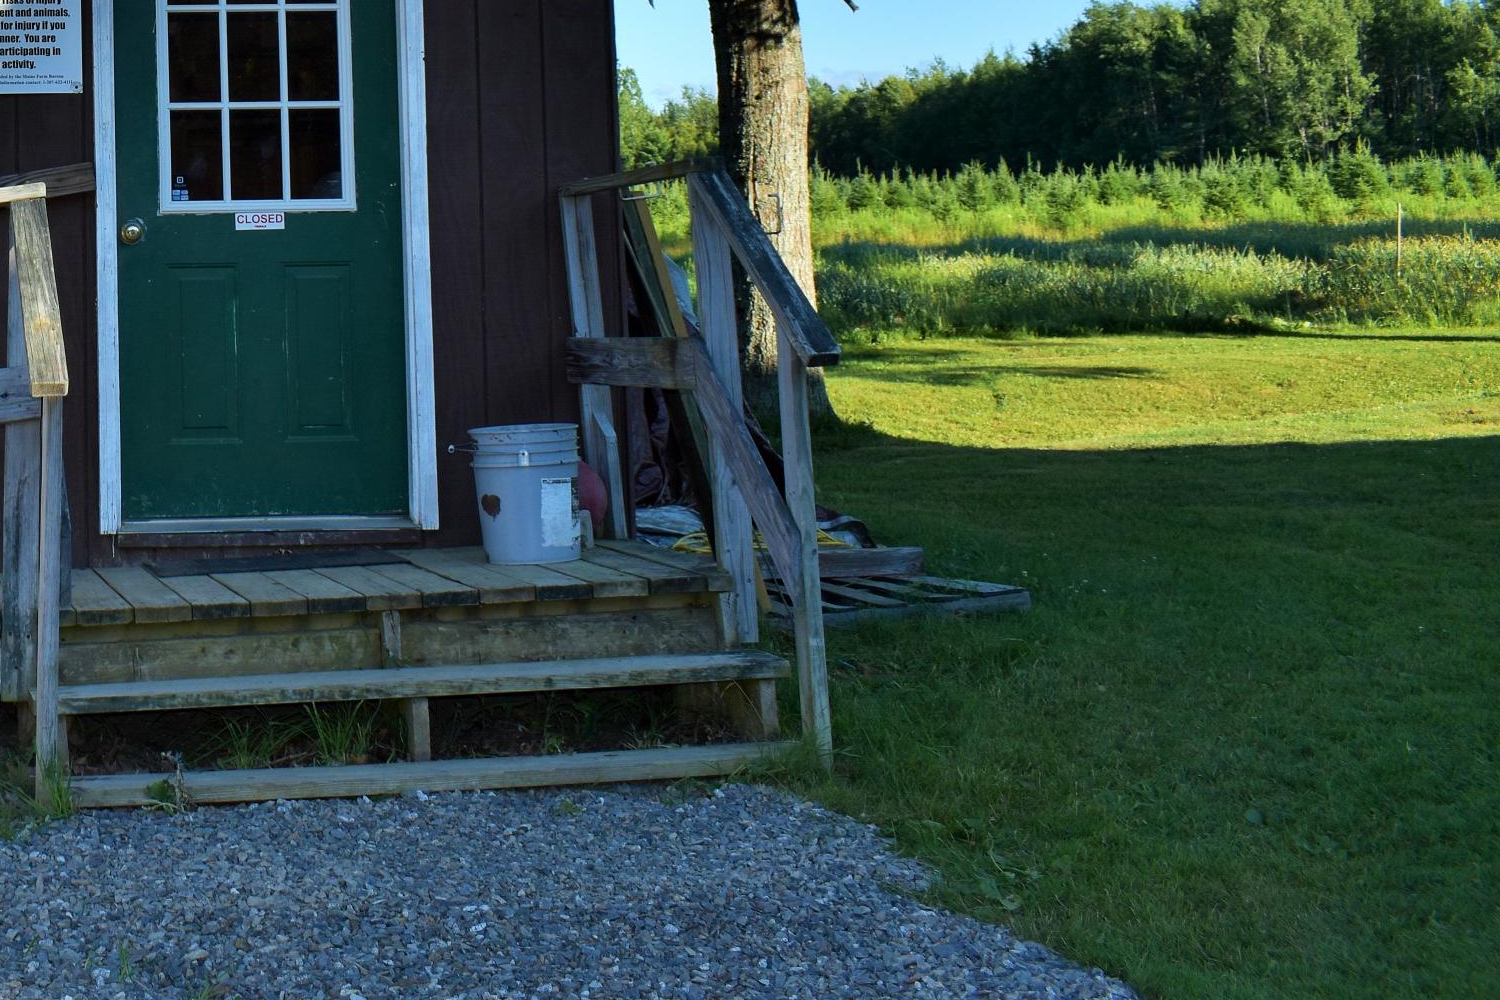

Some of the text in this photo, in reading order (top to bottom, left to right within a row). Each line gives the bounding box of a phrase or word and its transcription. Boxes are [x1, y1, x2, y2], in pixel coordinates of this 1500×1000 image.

[16, 9, 32, 17] and
[34, 8, 70, 17] animals,
[1, 21, 13, 30] for
[15, 21, 40, 31] injury
[42, 21, 48, 29] if
[50, 22, 65, 30] you
[24, 34, 40, 43] You
[53, 46, 61, 55] in
[2, 60, 36, 70] activity.
[237, 214, 283, 224] CLOSED
